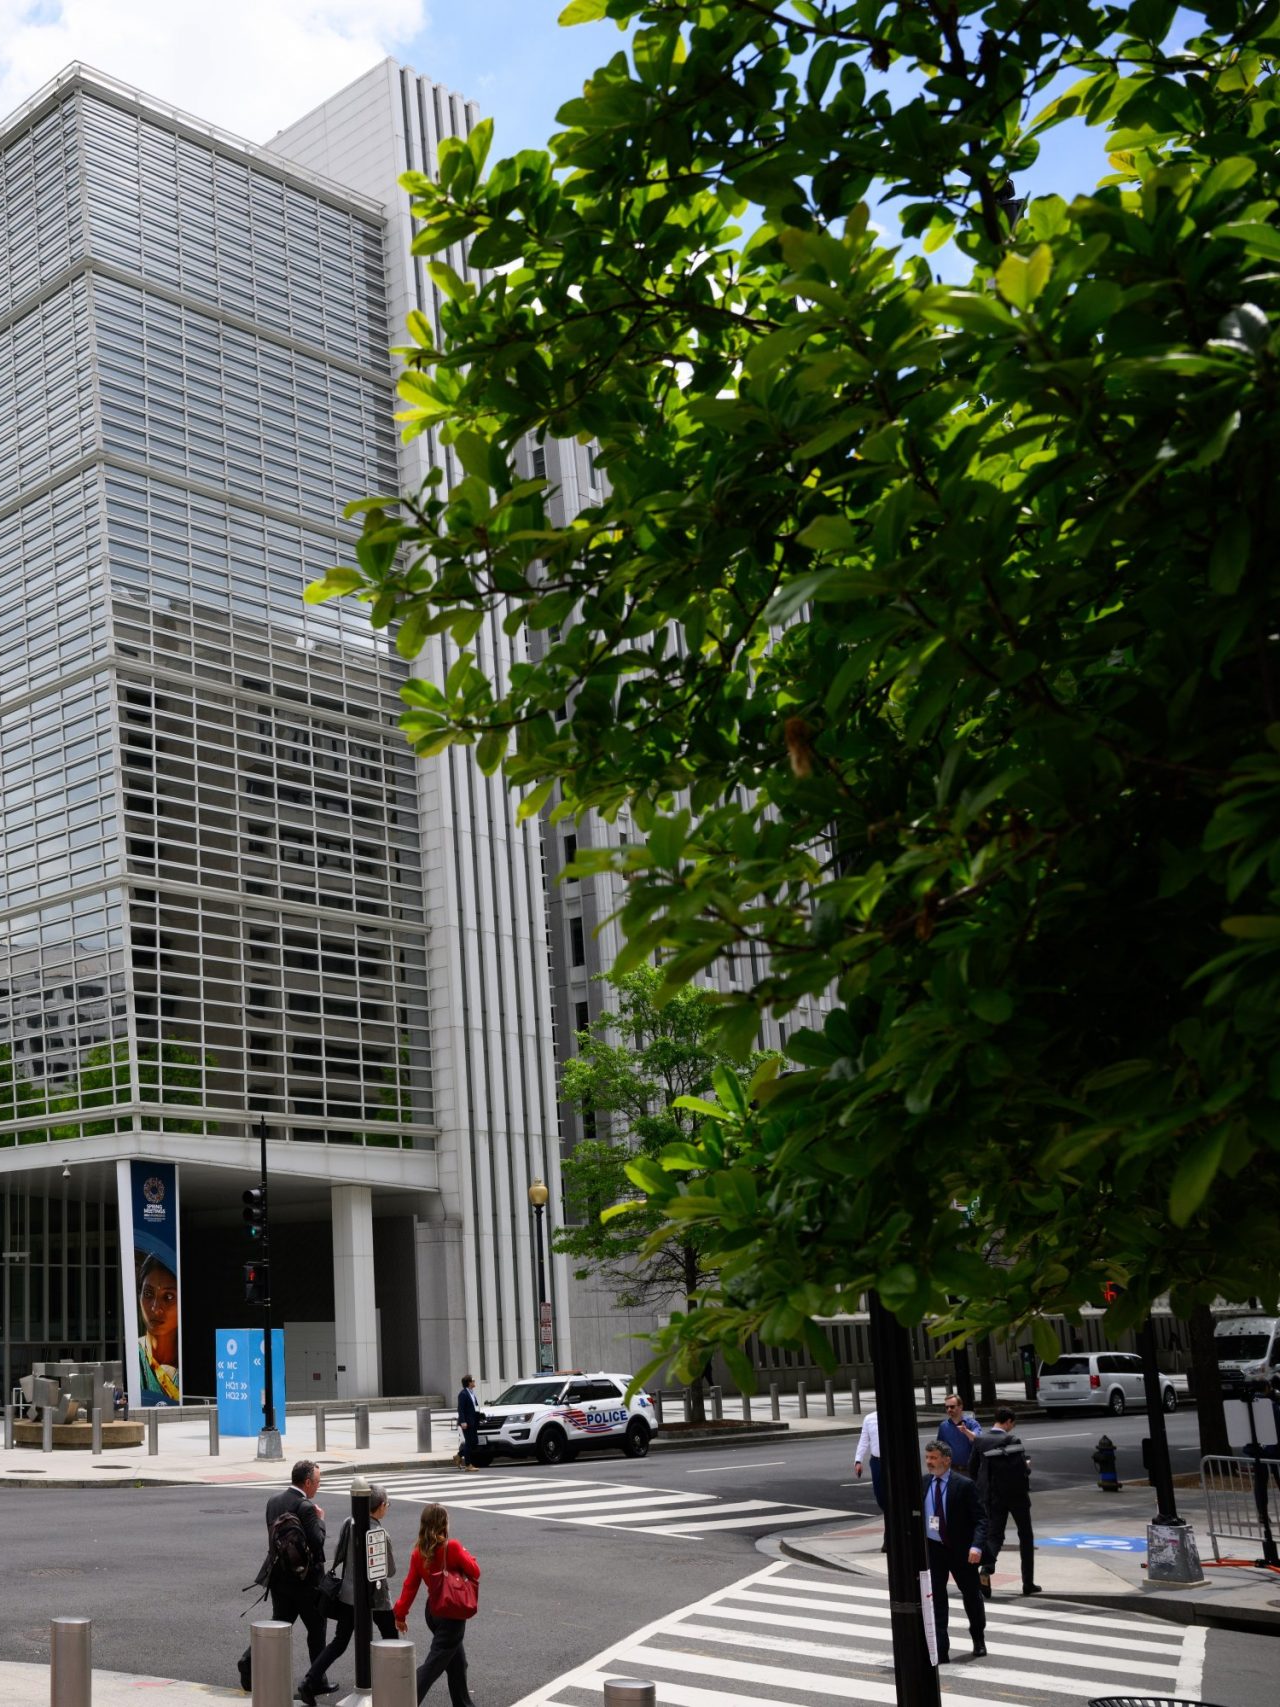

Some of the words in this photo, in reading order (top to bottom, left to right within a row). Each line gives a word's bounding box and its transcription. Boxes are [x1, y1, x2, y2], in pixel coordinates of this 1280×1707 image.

[230, 1372, 234, 1380] J
[225, 1382, 238, 1390] HQ1
[225, 1392, 239, 1400] HQ2
[587, 1410, 628, 1424] POLICE
